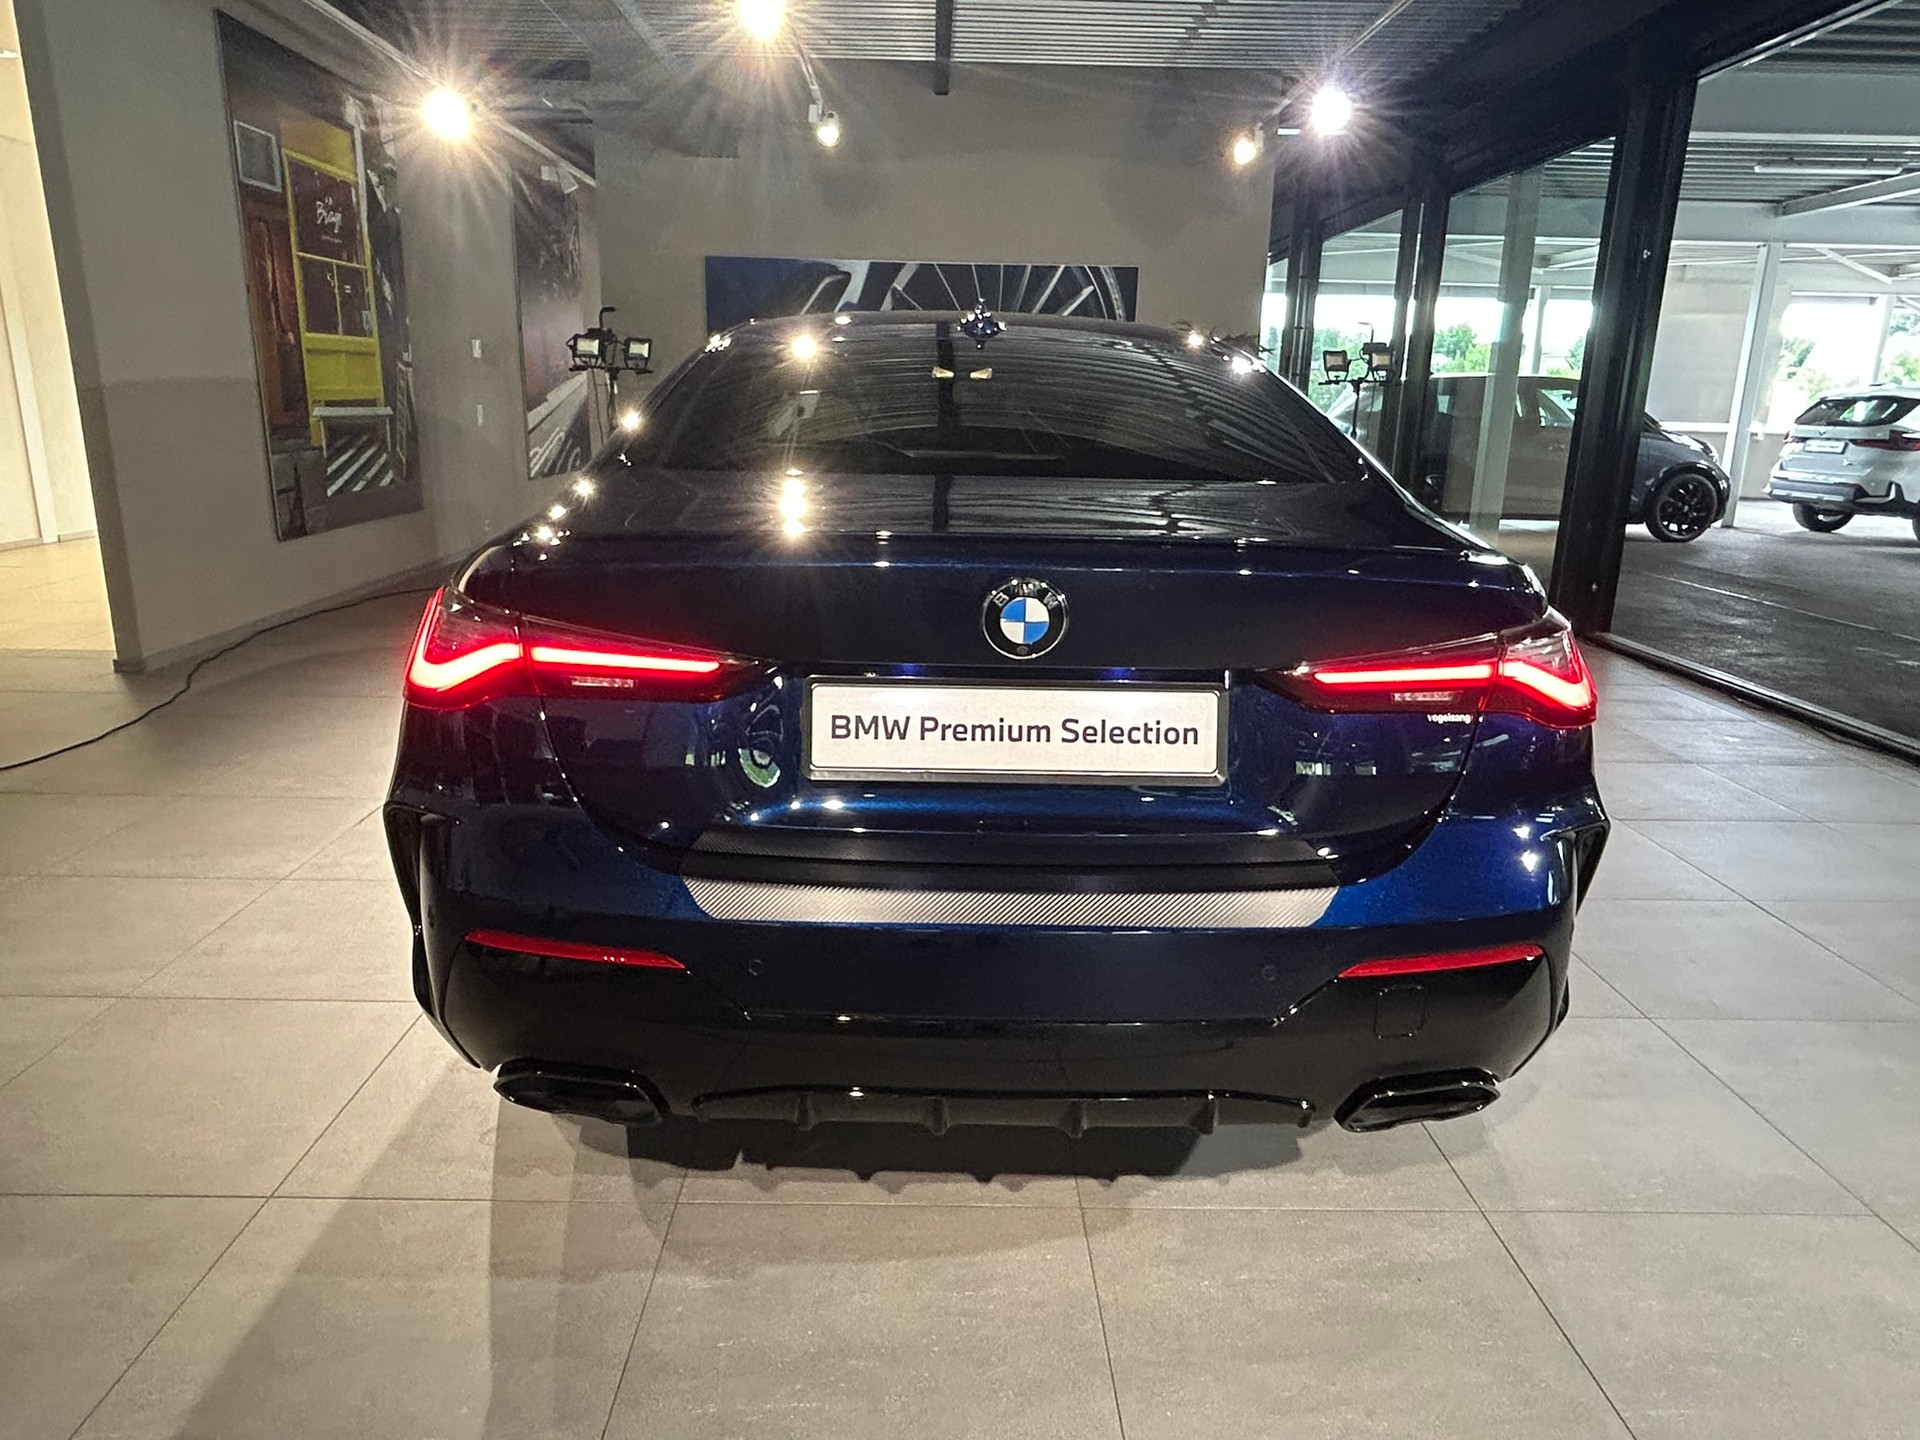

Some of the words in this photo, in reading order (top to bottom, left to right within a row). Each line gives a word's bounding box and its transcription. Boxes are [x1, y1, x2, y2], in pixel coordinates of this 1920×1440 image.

[993, 582, 1060, 610] BMW
[831, 714, 910, 740] BMW
[920, 716, 1050, 742] Premium
[1061, 718, 1198, 744] Selection
[1426, 712, 1471, 725] vogelsang
